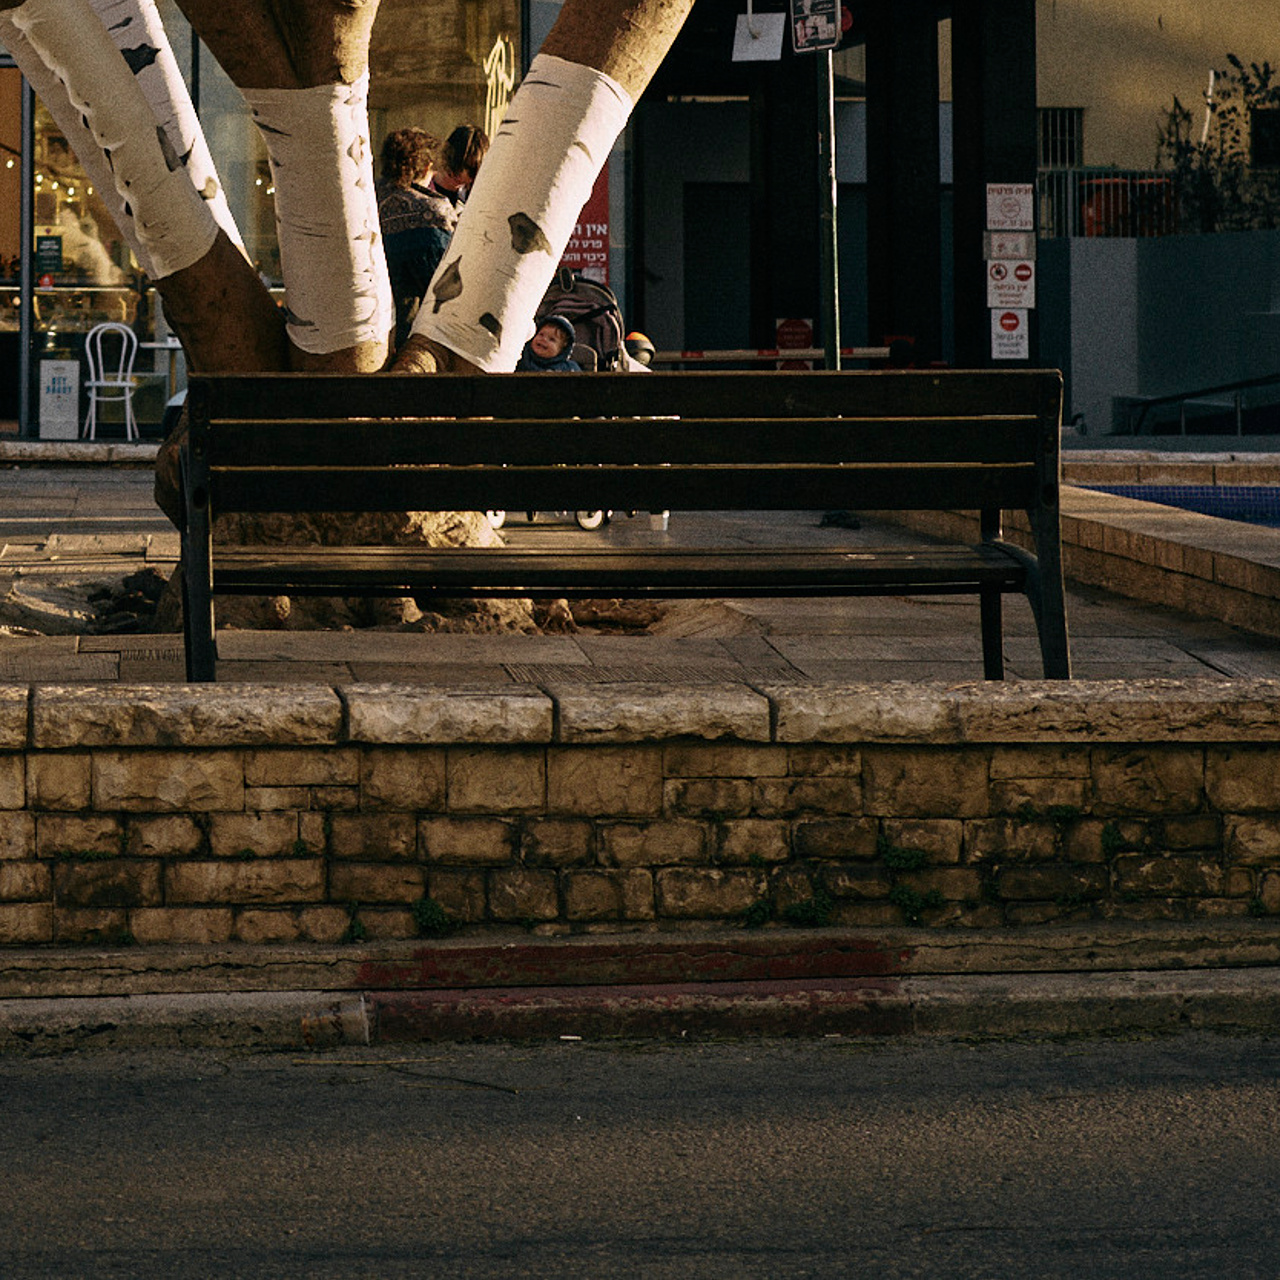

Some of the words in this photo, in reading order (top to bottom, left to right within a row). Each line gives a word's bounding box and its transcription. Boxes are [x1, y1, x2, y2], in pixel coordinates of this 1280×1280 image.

[585, 224, 607, 238] אין
[582, 240, 603, 248] פרט
[562, 253, 581, 262] והצ
[582, 253, 607, 261] כיבוי
